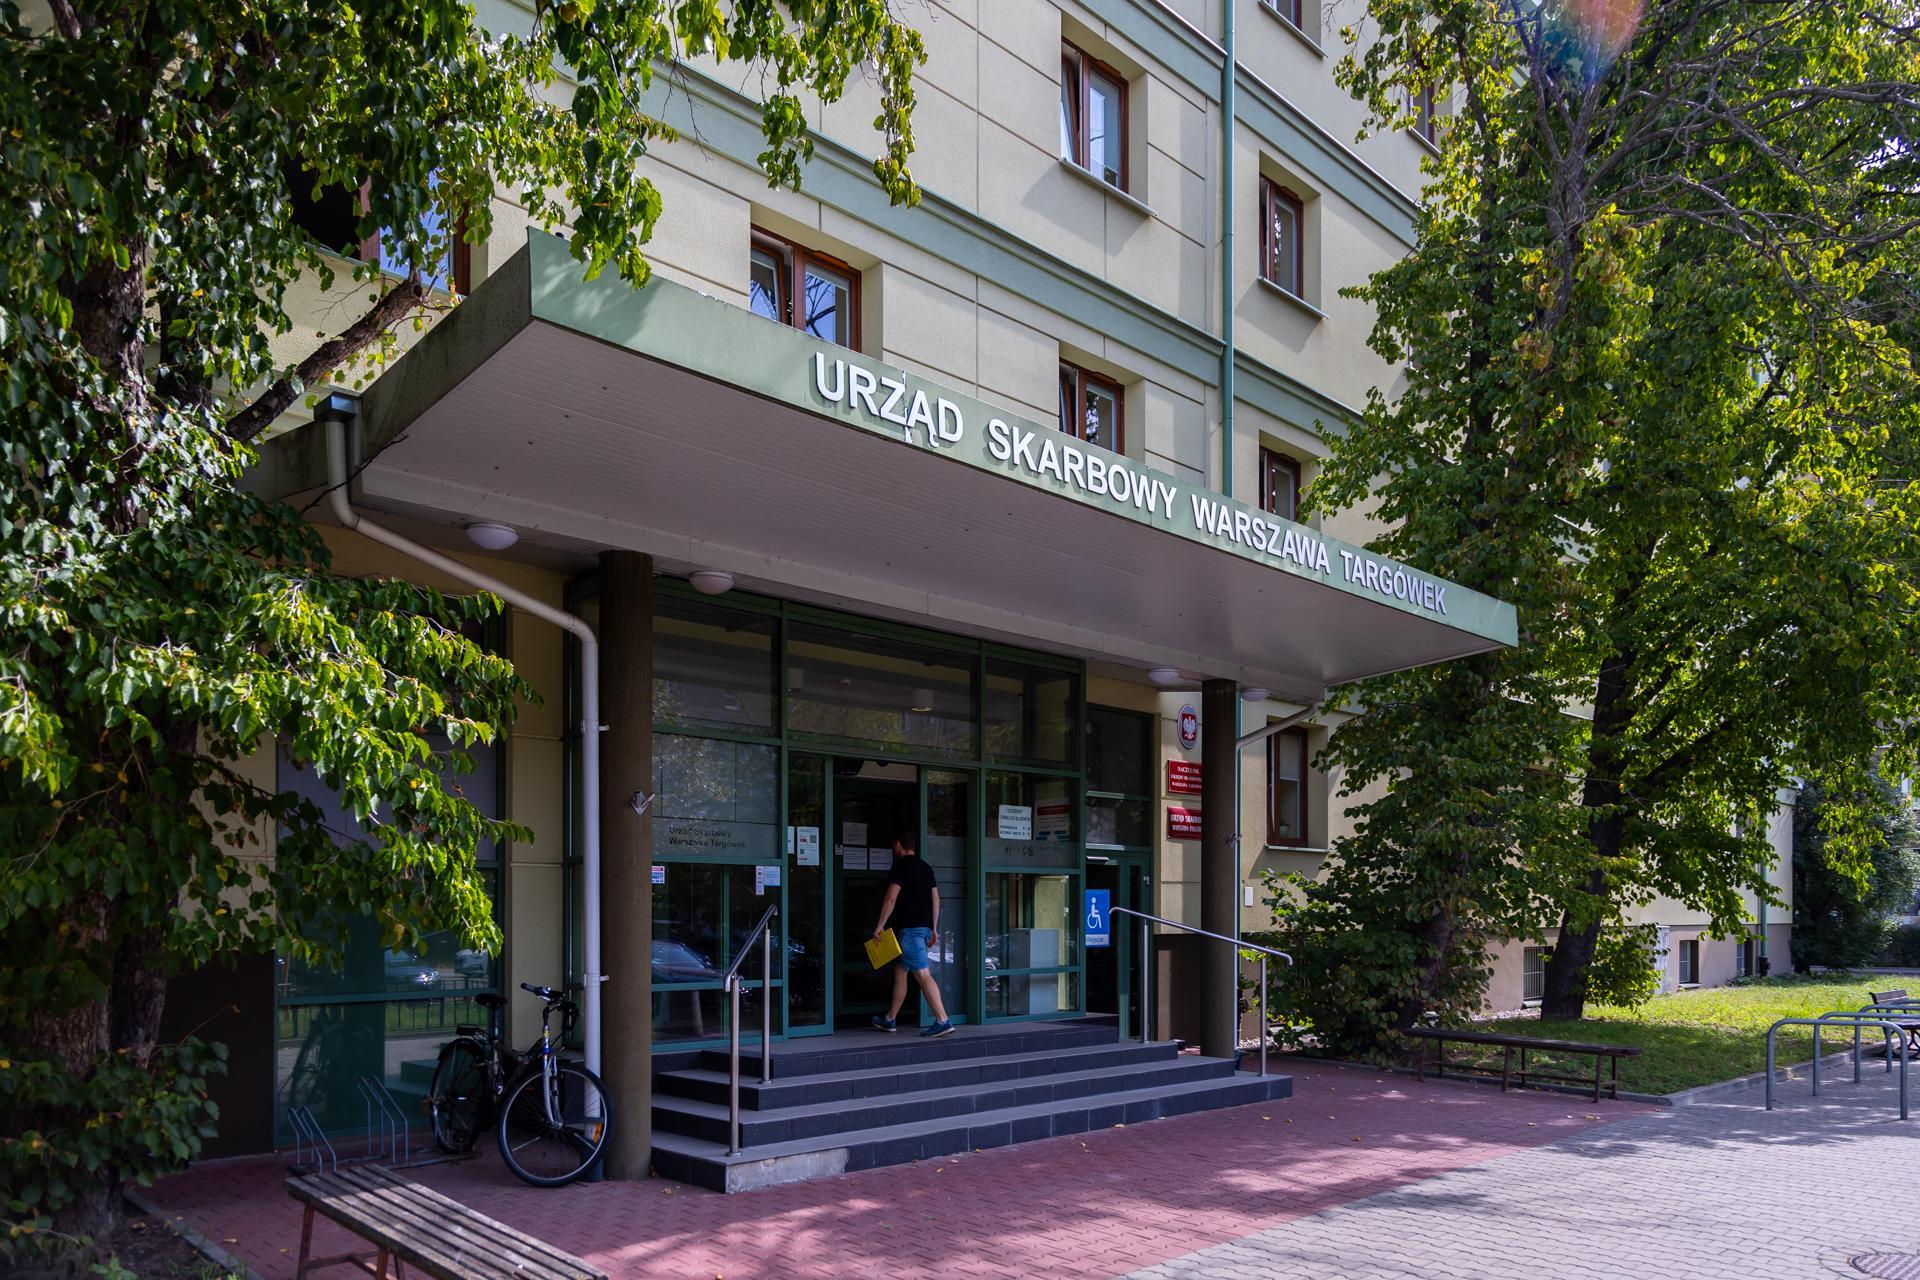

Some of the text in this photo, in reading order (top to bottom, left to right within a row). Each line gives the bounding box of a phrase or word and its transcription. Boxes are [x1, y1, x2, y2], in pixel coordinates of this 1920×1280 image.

[815, 351, 1448, 615] URZĄD SKARBOWY WARSZAWA TARGÓWEK
